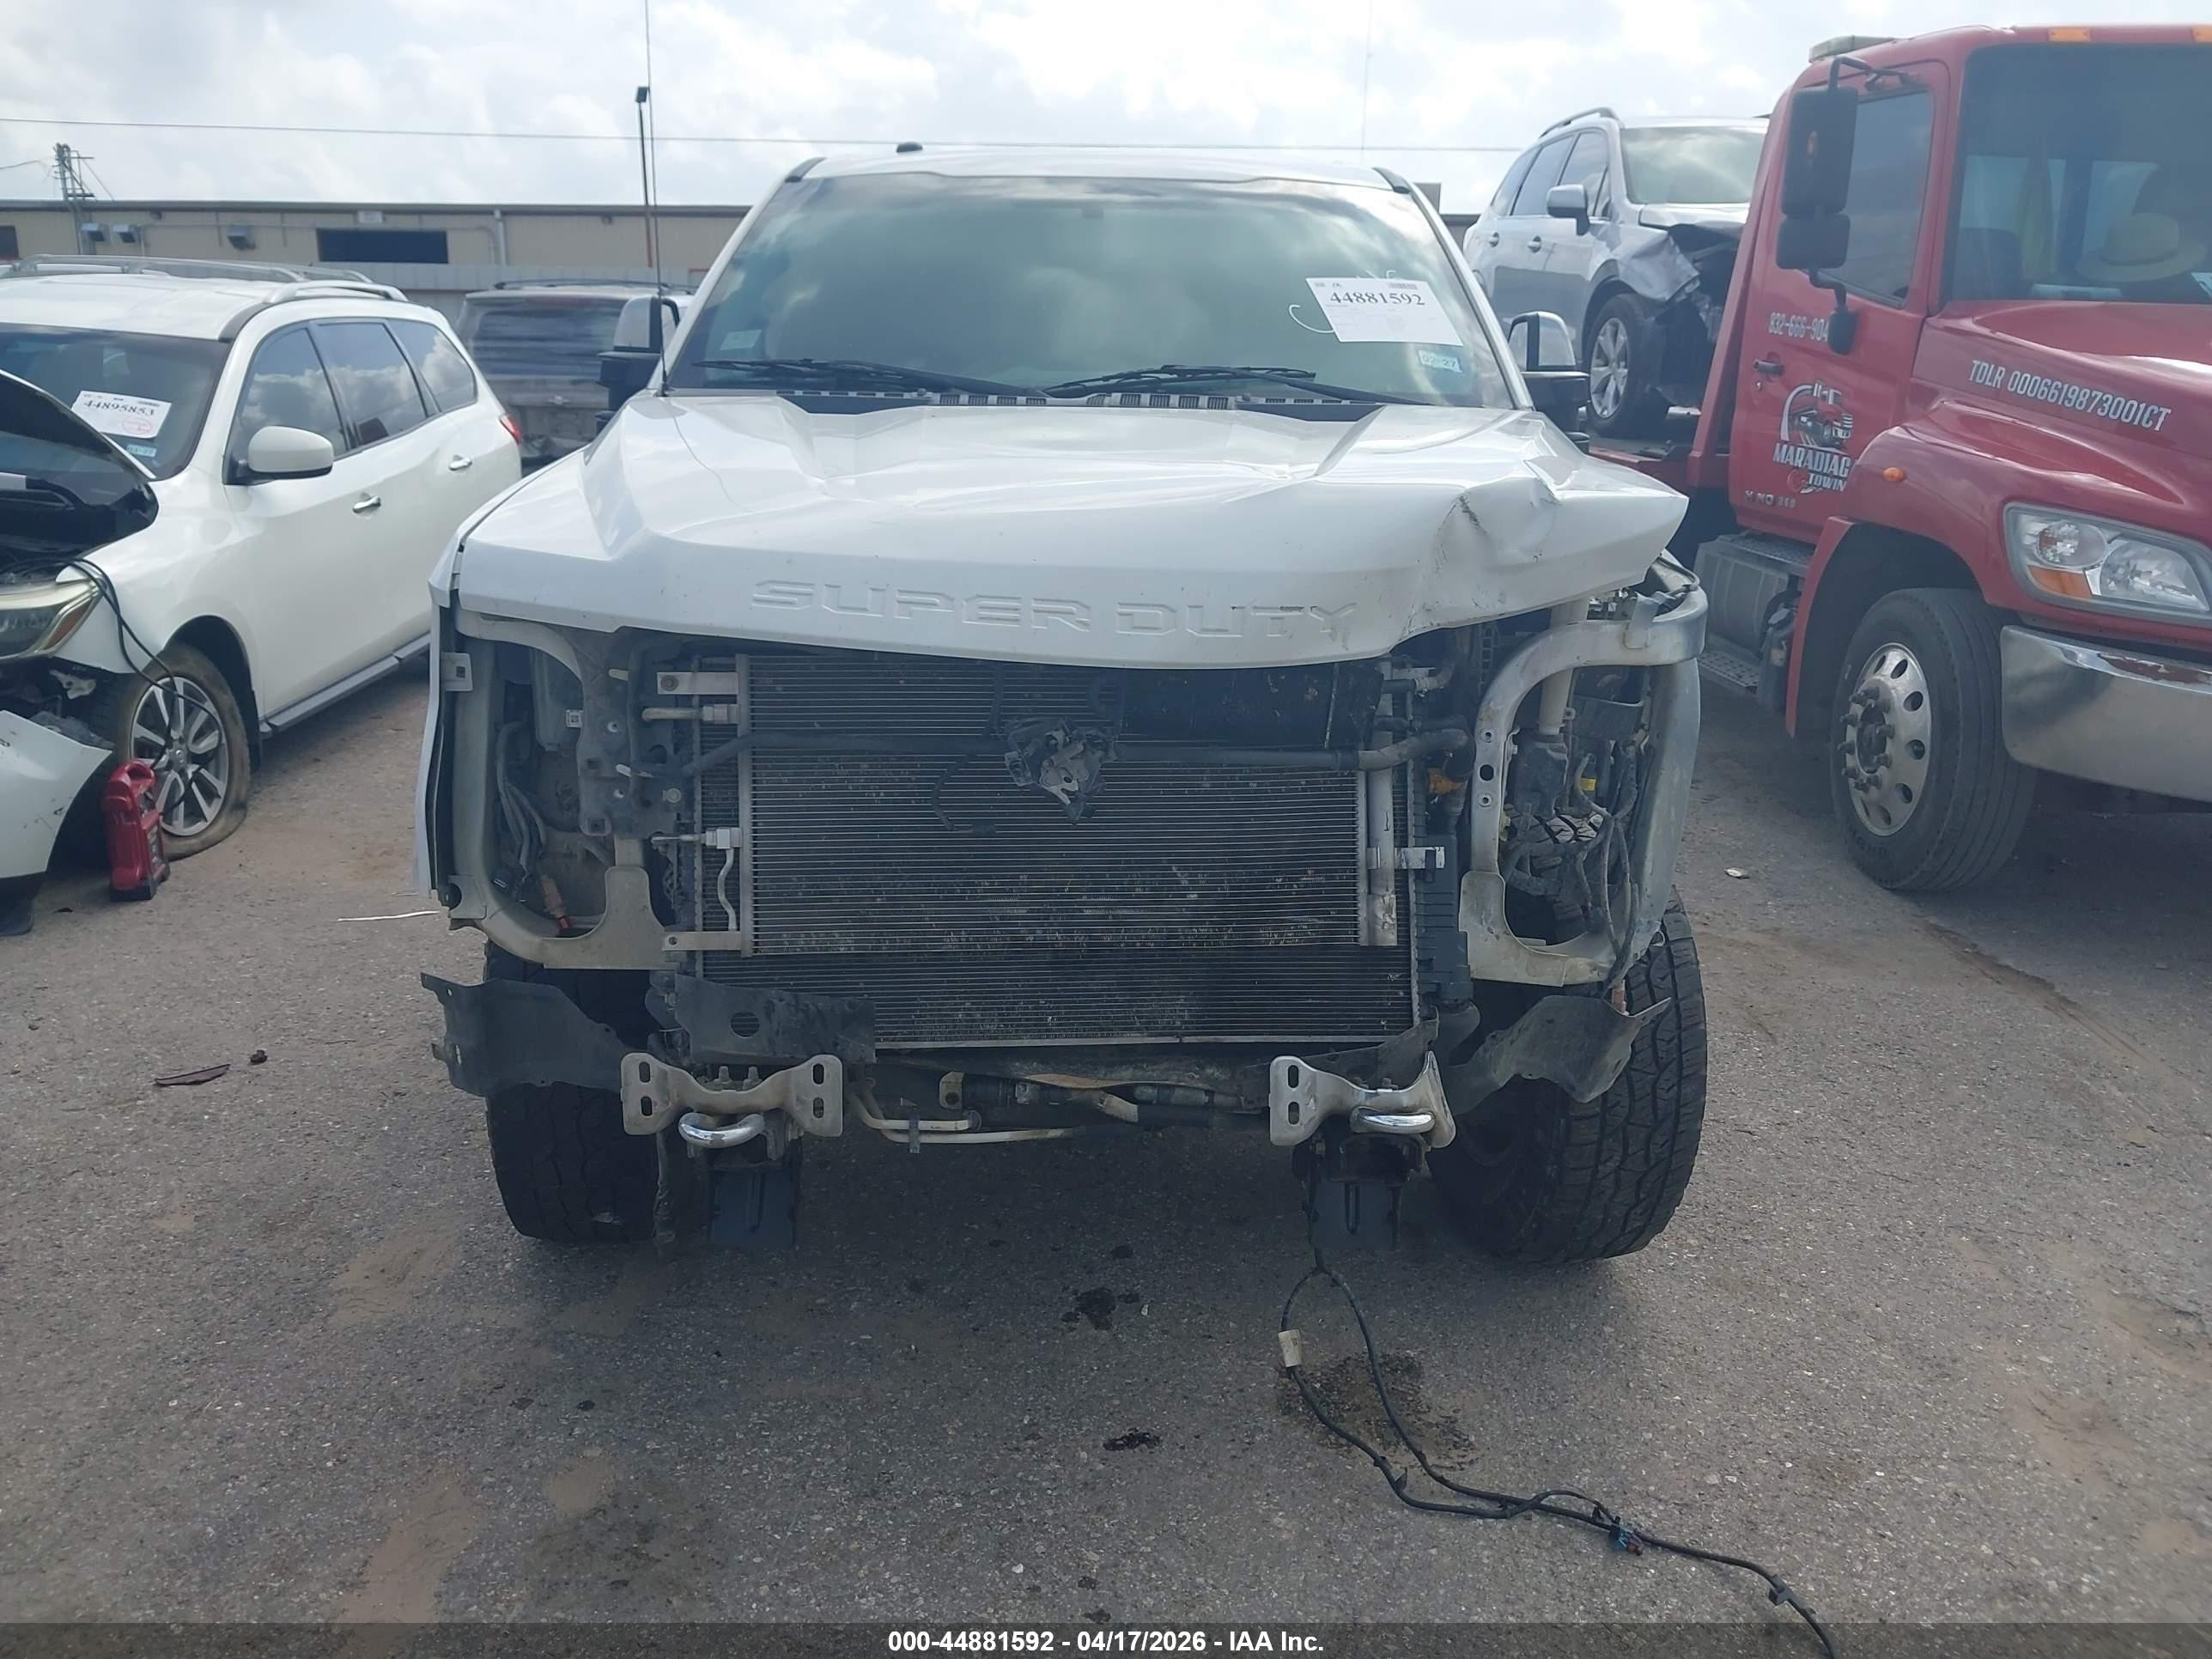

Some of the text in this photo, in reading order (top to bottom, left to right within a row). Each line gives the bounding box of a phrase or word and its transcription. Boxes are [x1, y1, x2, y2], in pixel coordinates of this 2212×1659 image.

[1330, 292, 1425, 306] 44881592
[83, 399, 155, 416] 44895853
[1968, 360, 2172, 431] TDLR 0006619873001CT
[751, 580, 1358, 638] SUPER DUTY
